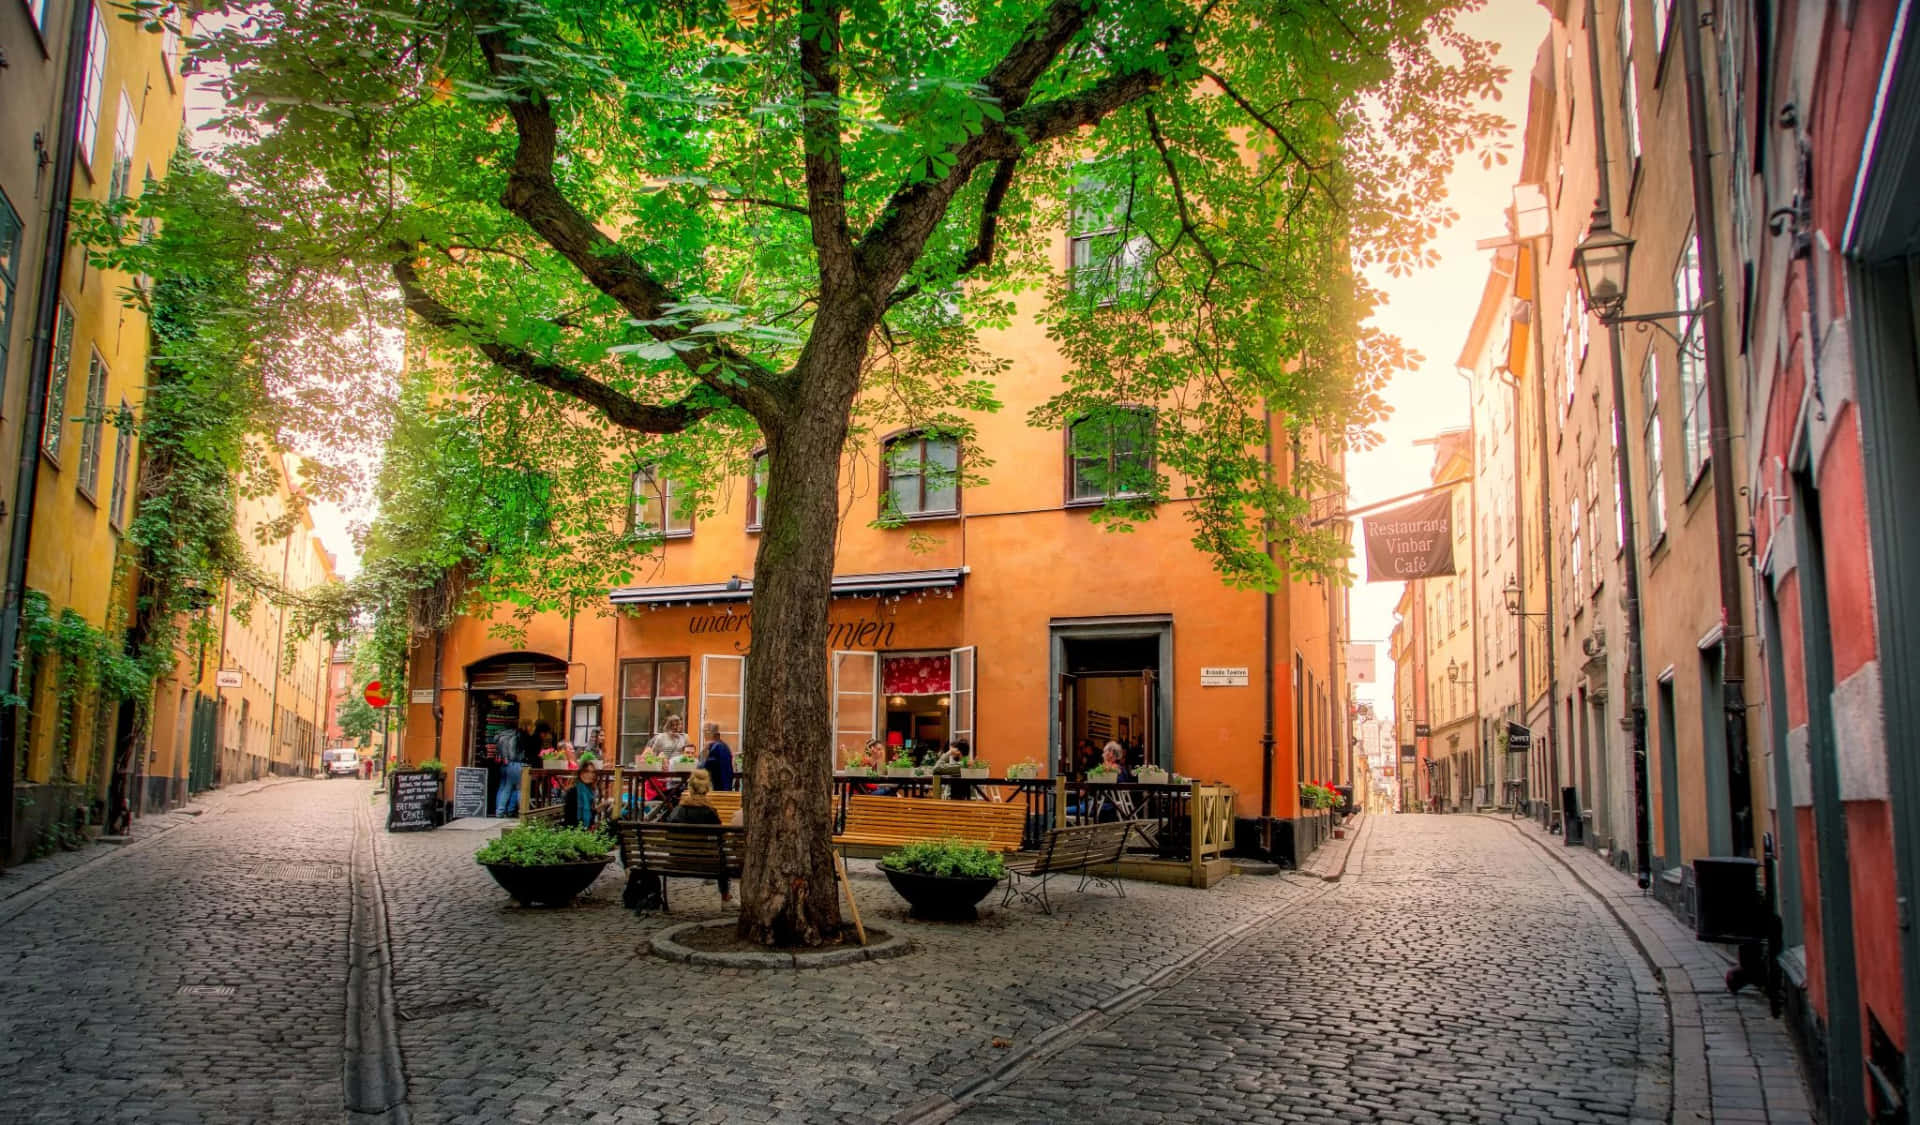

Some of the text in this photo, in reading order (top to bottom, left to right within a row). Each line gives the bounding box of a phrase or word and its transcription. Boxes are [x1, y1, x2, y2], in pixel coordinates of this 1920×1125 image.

[1368, 519, 1448, 537] Restaurang
[1386, 537, 1432, 554] Vinbar
[1394, 556, 1427, 574] Café
[690, 611, 748, 635] under
